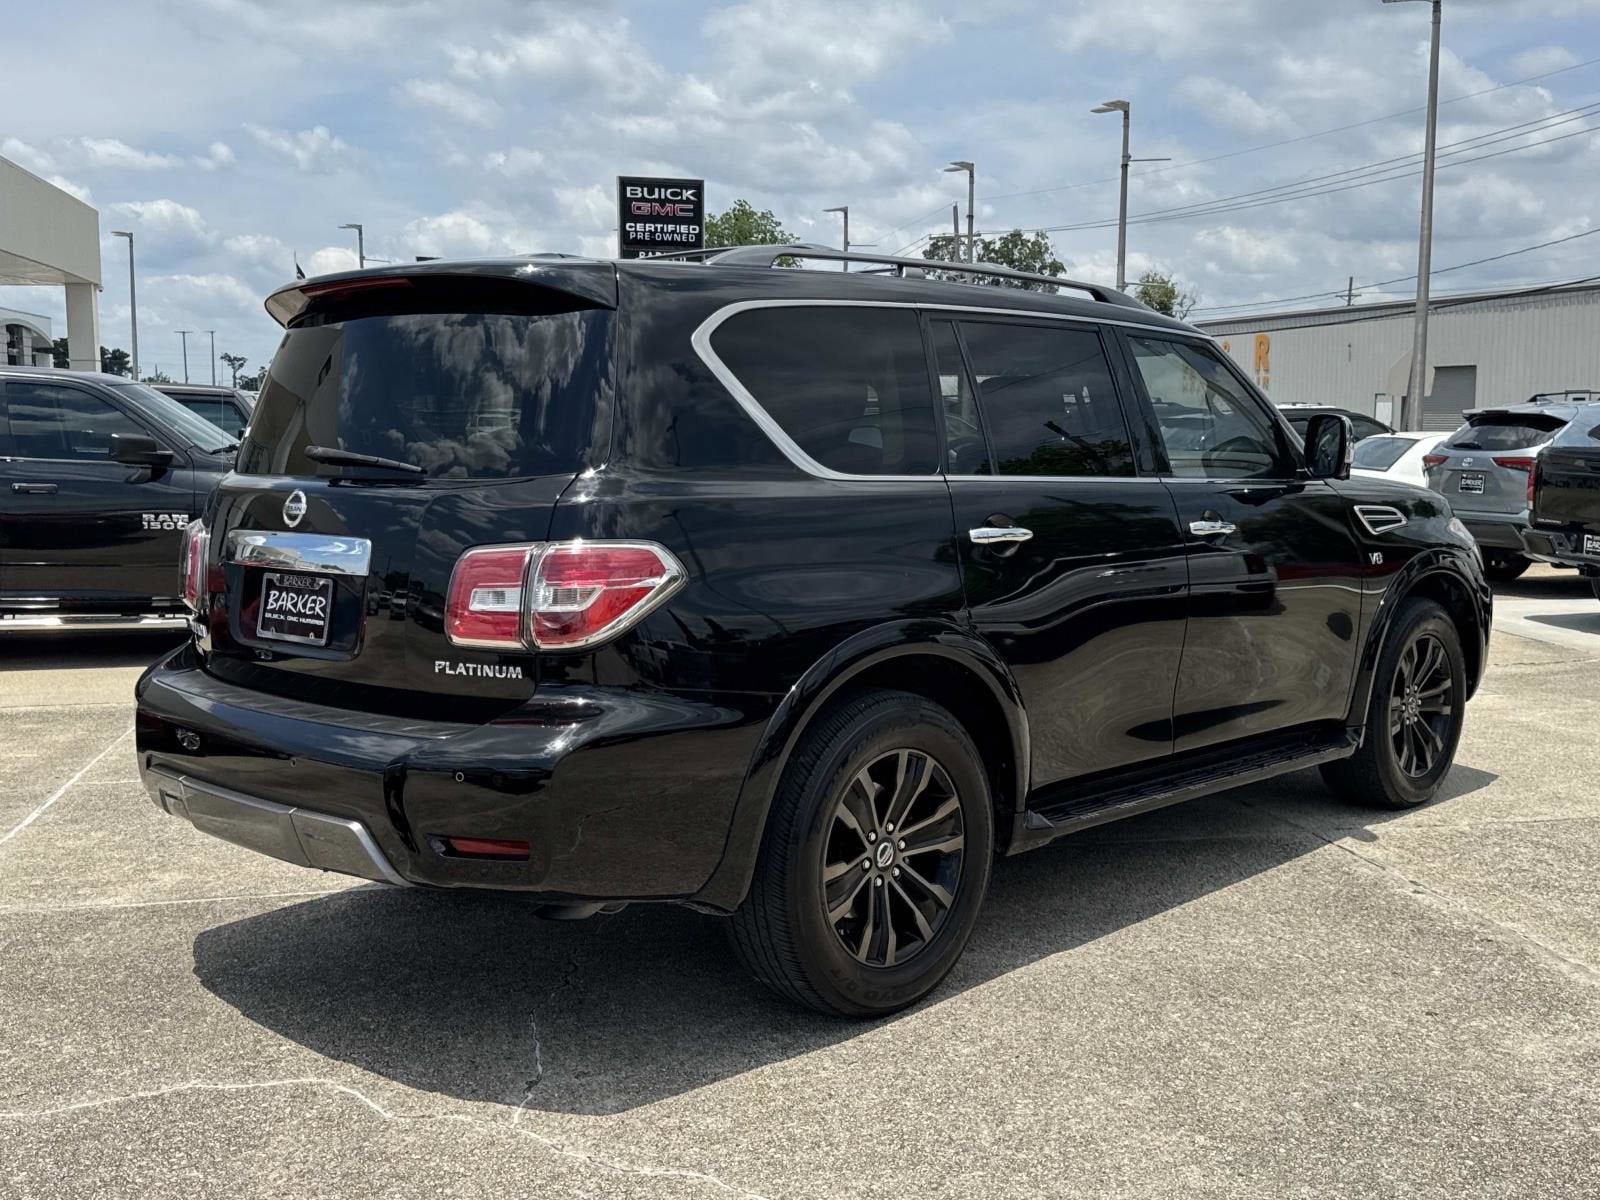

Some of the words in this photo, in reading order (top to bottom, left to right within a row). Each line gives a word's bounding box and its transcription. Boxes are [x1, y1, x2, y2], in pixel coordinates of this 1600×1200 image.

[626, 186, 698, 201] BUICK
[631, 201, 694, 217] GMC
[625, 222, 700, 234] CERTIFIED
[629, 231, 696, 242] PRE-OWNED
[142, 513, 190, 522] RAM
[142, 521, 189, 530] 1500
[1368, 551, 1384, 565] V8
[266, 590, 326, 618] BARKER
[434, 660, 523, 679] PLATINUM
